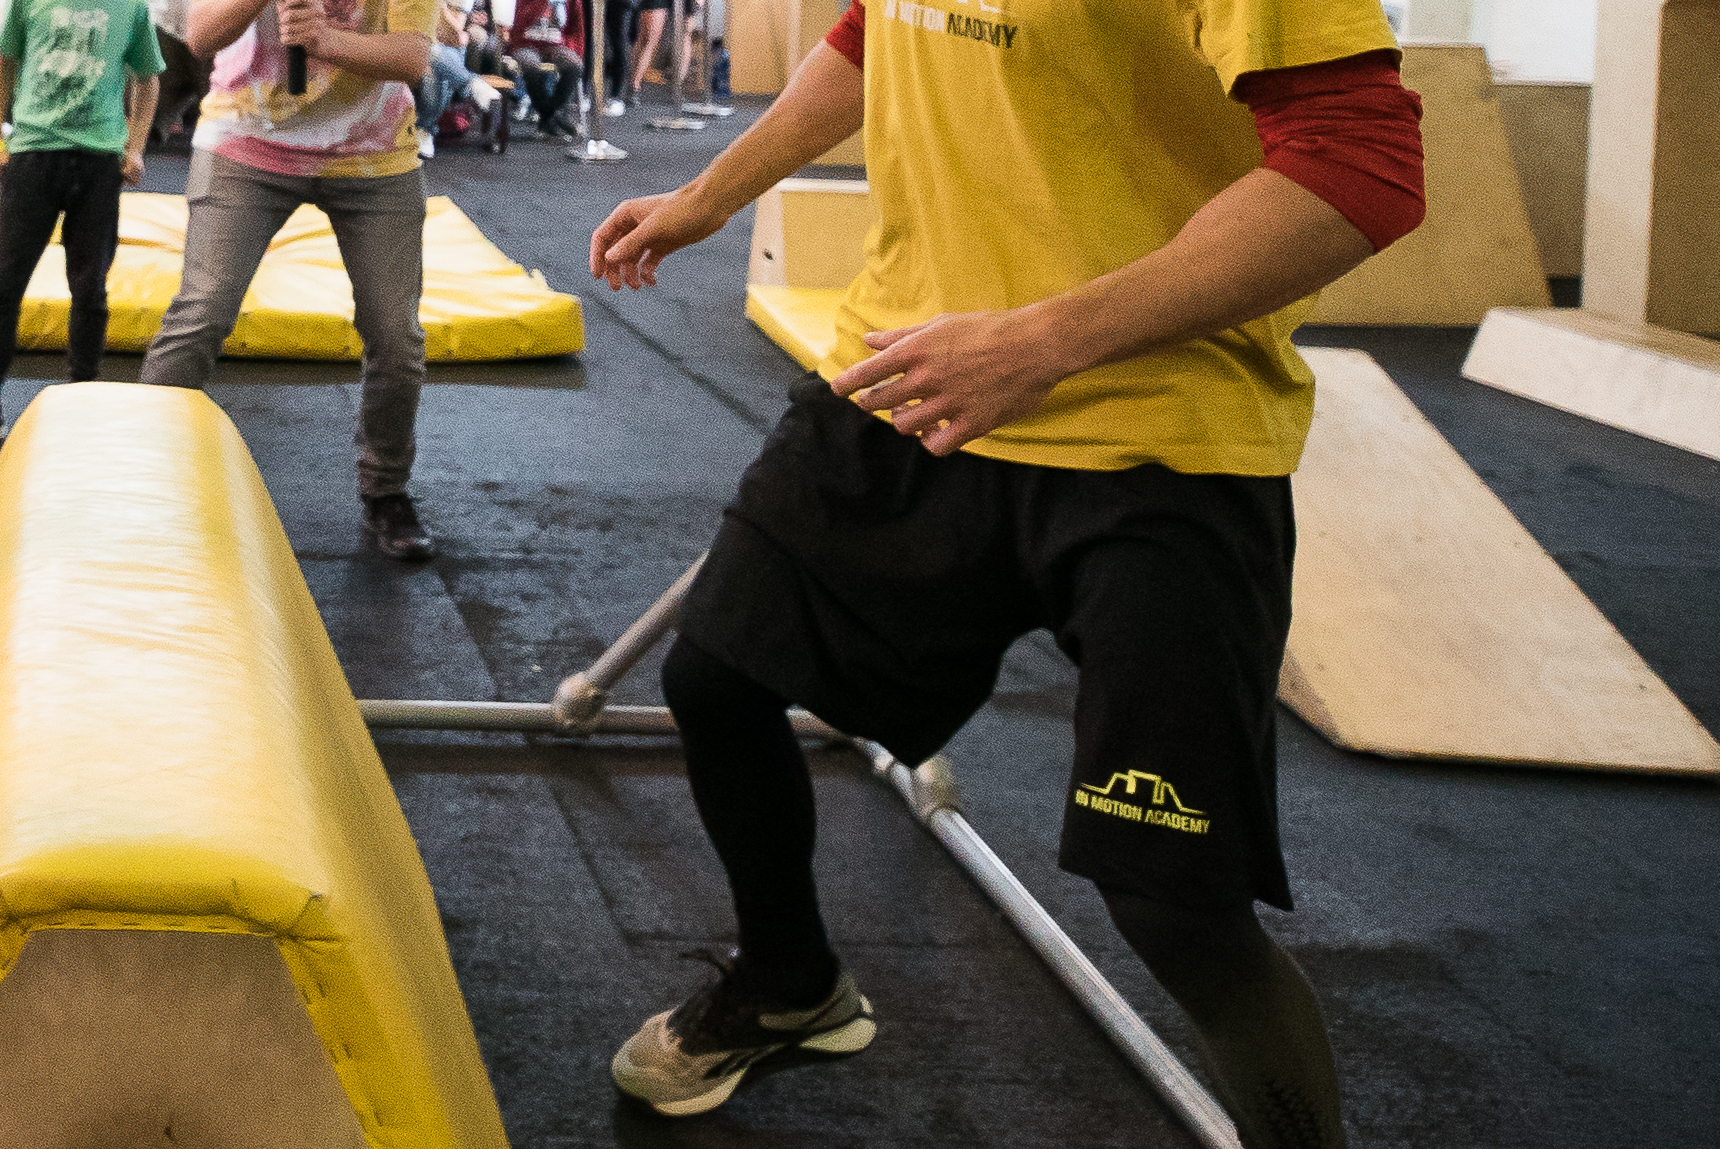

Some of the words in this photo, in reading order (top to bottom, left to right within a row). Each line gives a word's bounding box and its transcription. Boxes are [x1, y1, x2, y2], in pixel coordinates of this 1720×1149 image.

[1075, 789, 1090, 807] IN
[1090, 794, 1143, 822] MOTION
[1144, 808, 1211, 834] ACADEMY
